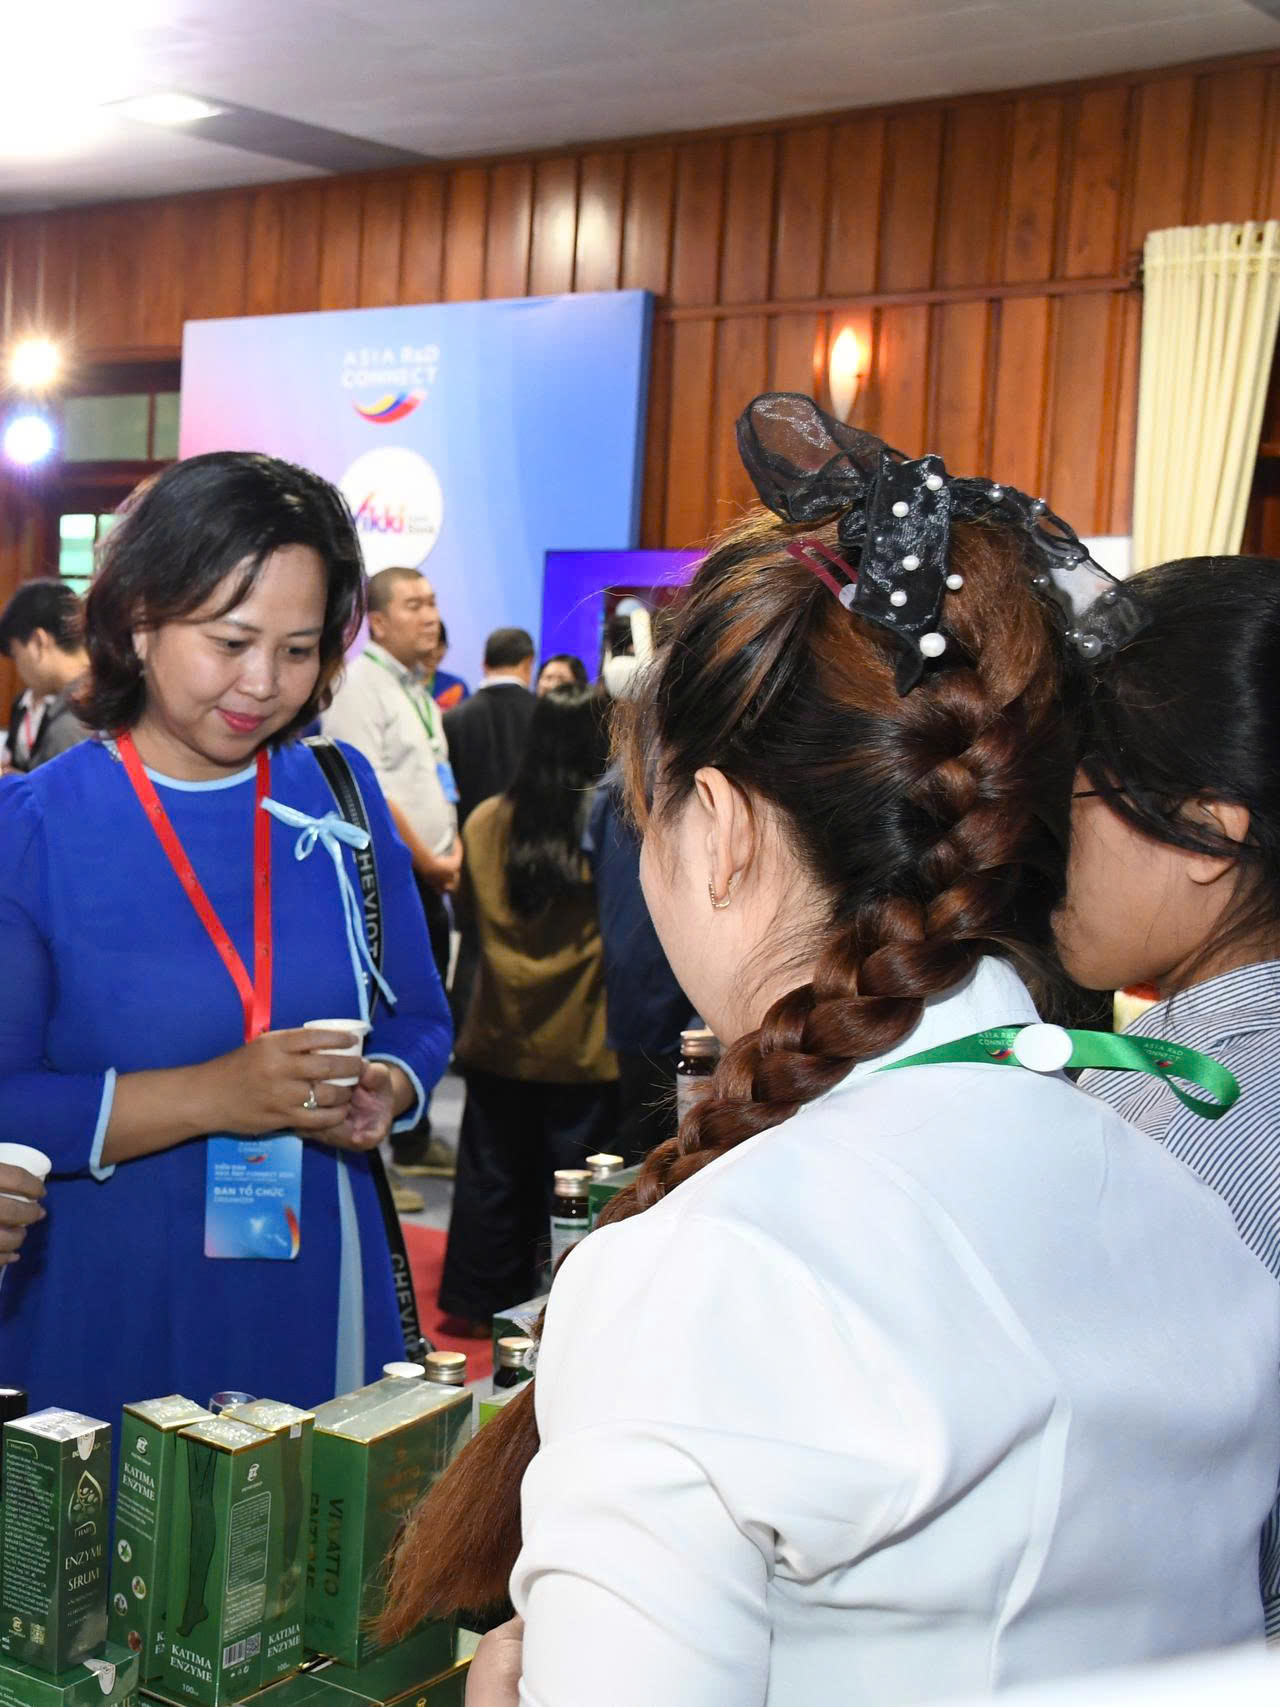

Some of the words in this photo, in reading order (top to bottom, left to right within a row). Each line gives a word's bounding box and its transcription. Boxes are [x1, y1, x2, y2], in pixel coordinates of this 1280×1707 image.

[341, 367, 438, 388] CONNECT
[357, 852, 379, 958] HEVIOT
[978, 1038, 1013, 1047] CONNEC
[122, 1473, 155, 1501] ENZYME
[124, 1462, 155, 1488] KATIMA
[68, 1567, 100, 1592] SERUM
[267, 1634, 301, 1657] ENZYME
[268, 1623, 301, 1645] KATIMA
[170, 1656, 213, 1682] ENZYME
[171, 1644, 212, 1670] KATIMA
